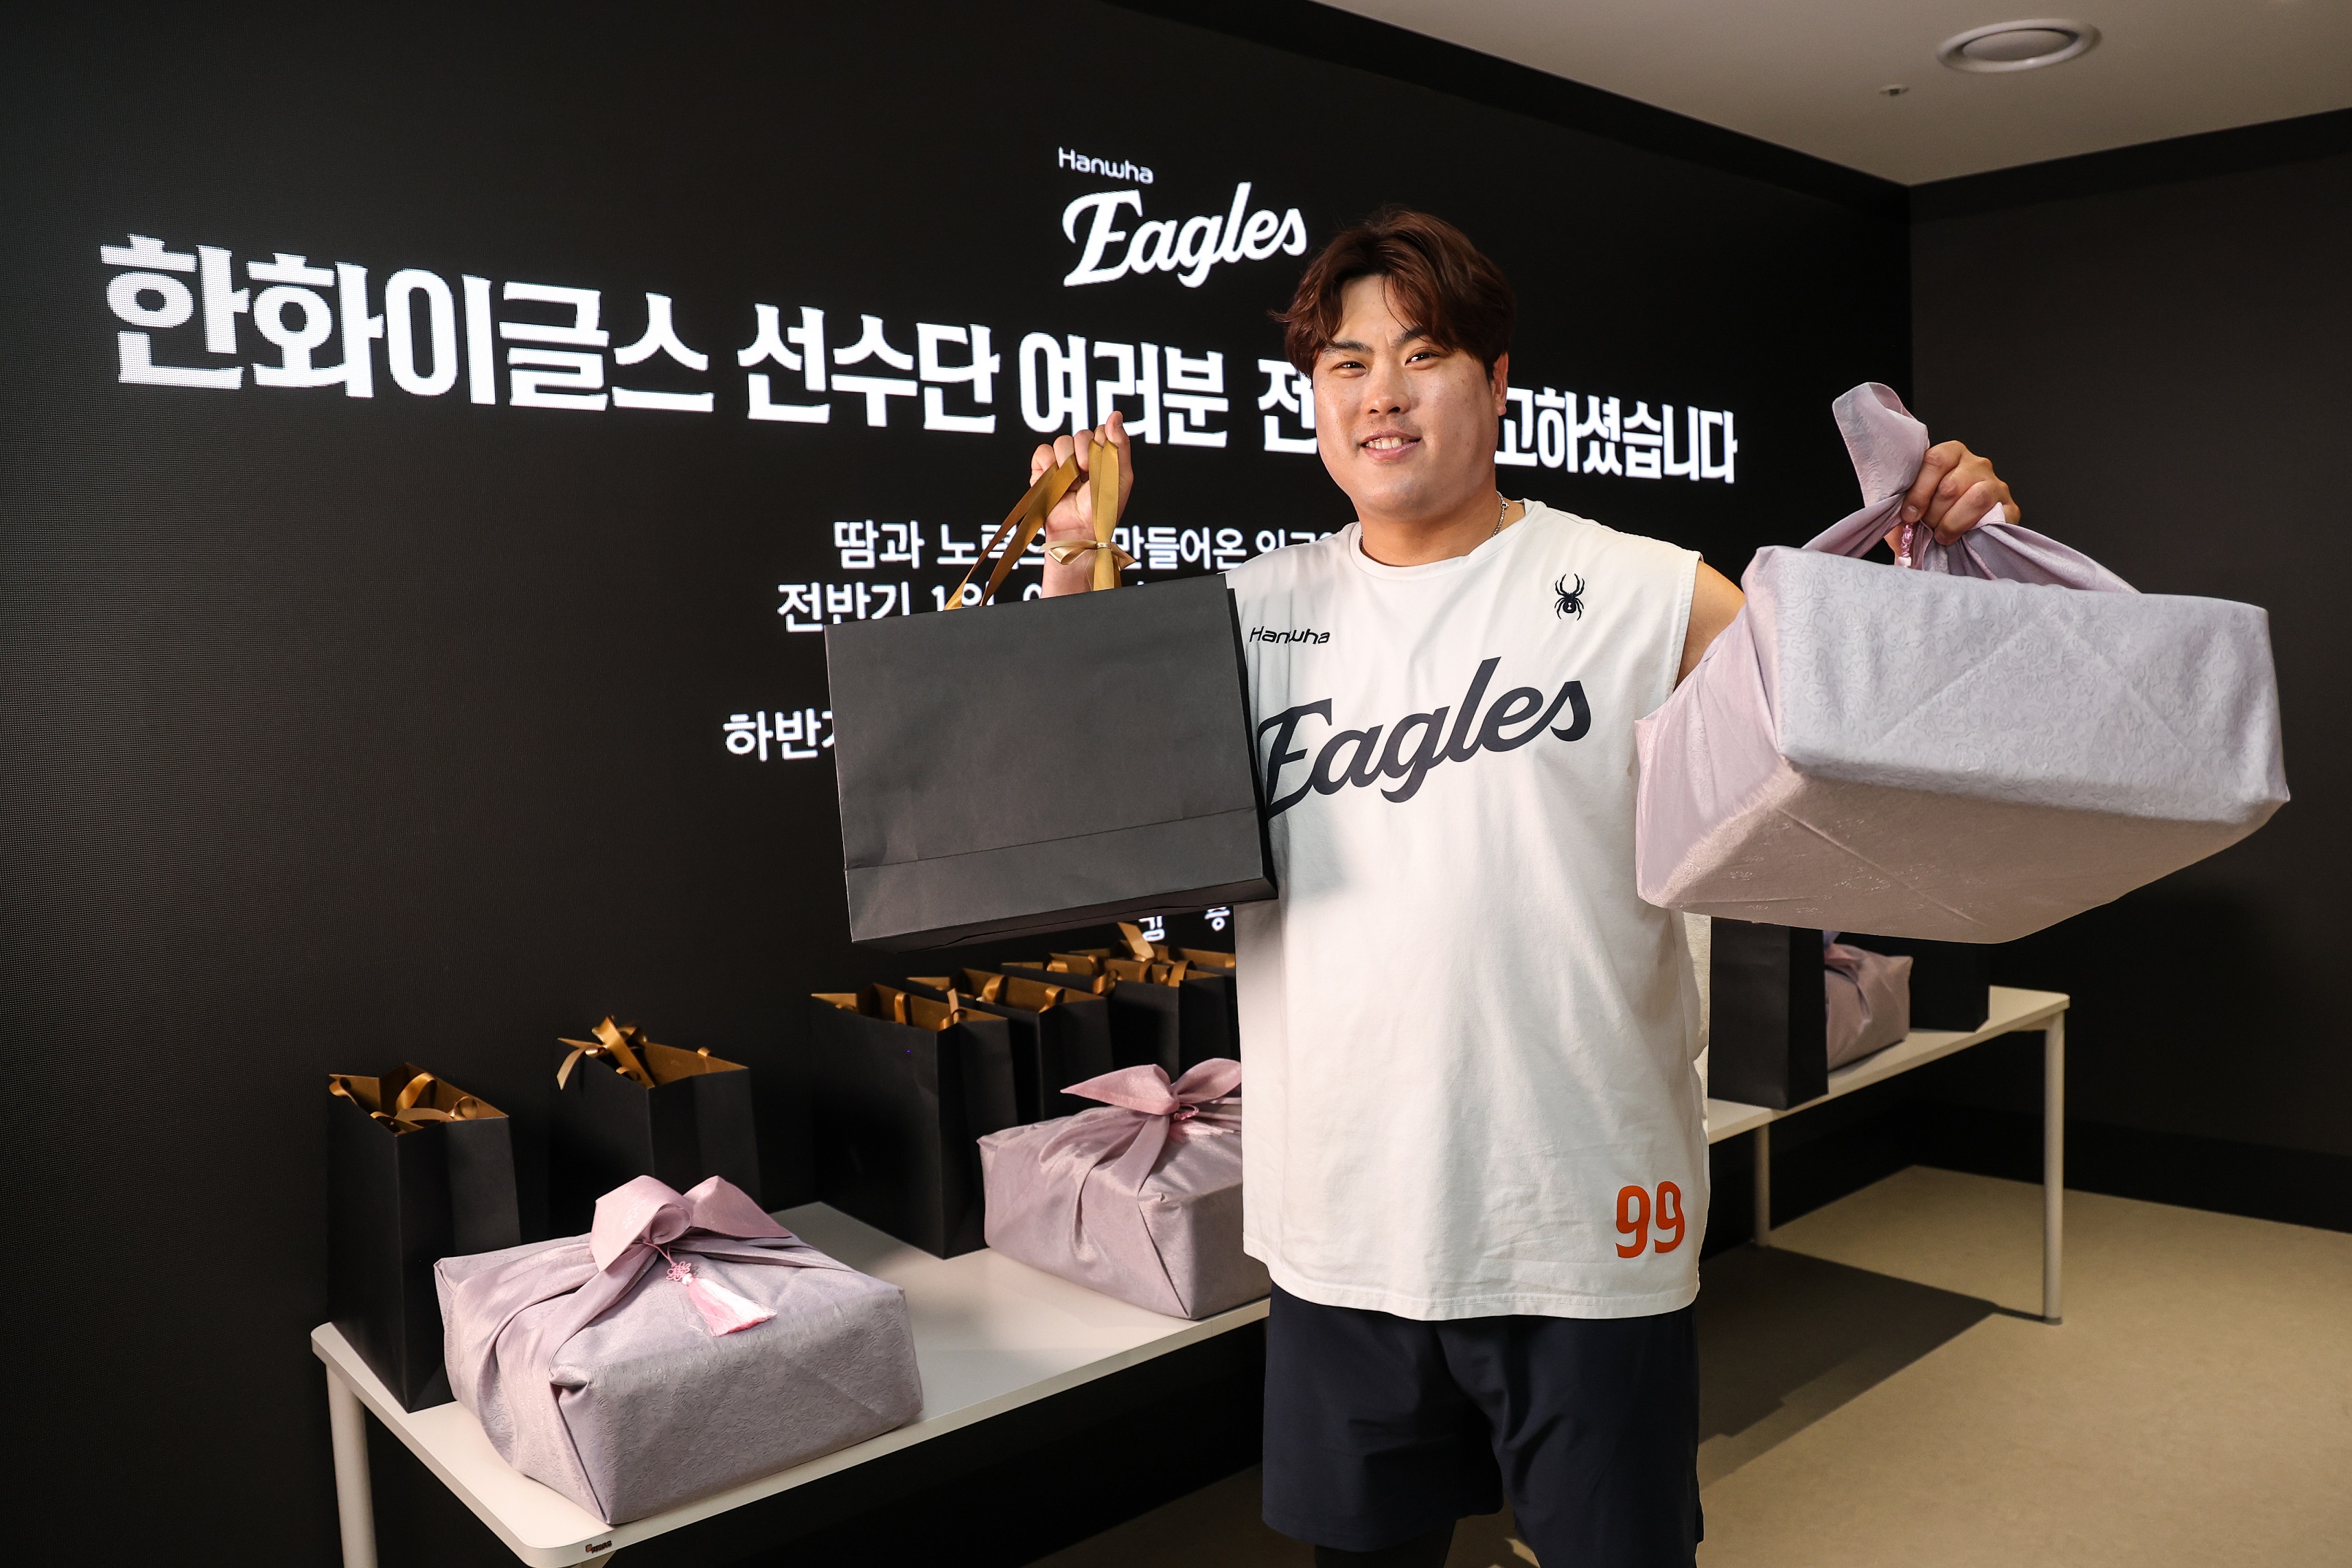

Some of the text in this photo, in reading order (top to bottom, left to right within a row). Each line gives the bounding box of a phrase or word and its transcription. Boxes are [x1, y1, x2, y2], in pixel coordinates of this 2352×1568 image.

[1058, 147, 1154, 184] Hanwha
[1062, 182, 1307, 288] Eagles
[100, 234, 715, 412] 한화이글스
[737, 303, 1000, 434] 선수단
[1019, 331, 1229, 447] 여러분
[1494, 386, 1738, 484] 고하셨습니다
[834, 519, 925, 569] 땀과
[777, 581, 911, 632] 전반기
[1249, 626, 1331, 645] Hanwha
[1256, 656, 1591, 821] Eagles
[1615, 1180, 1686, 1258] 99
